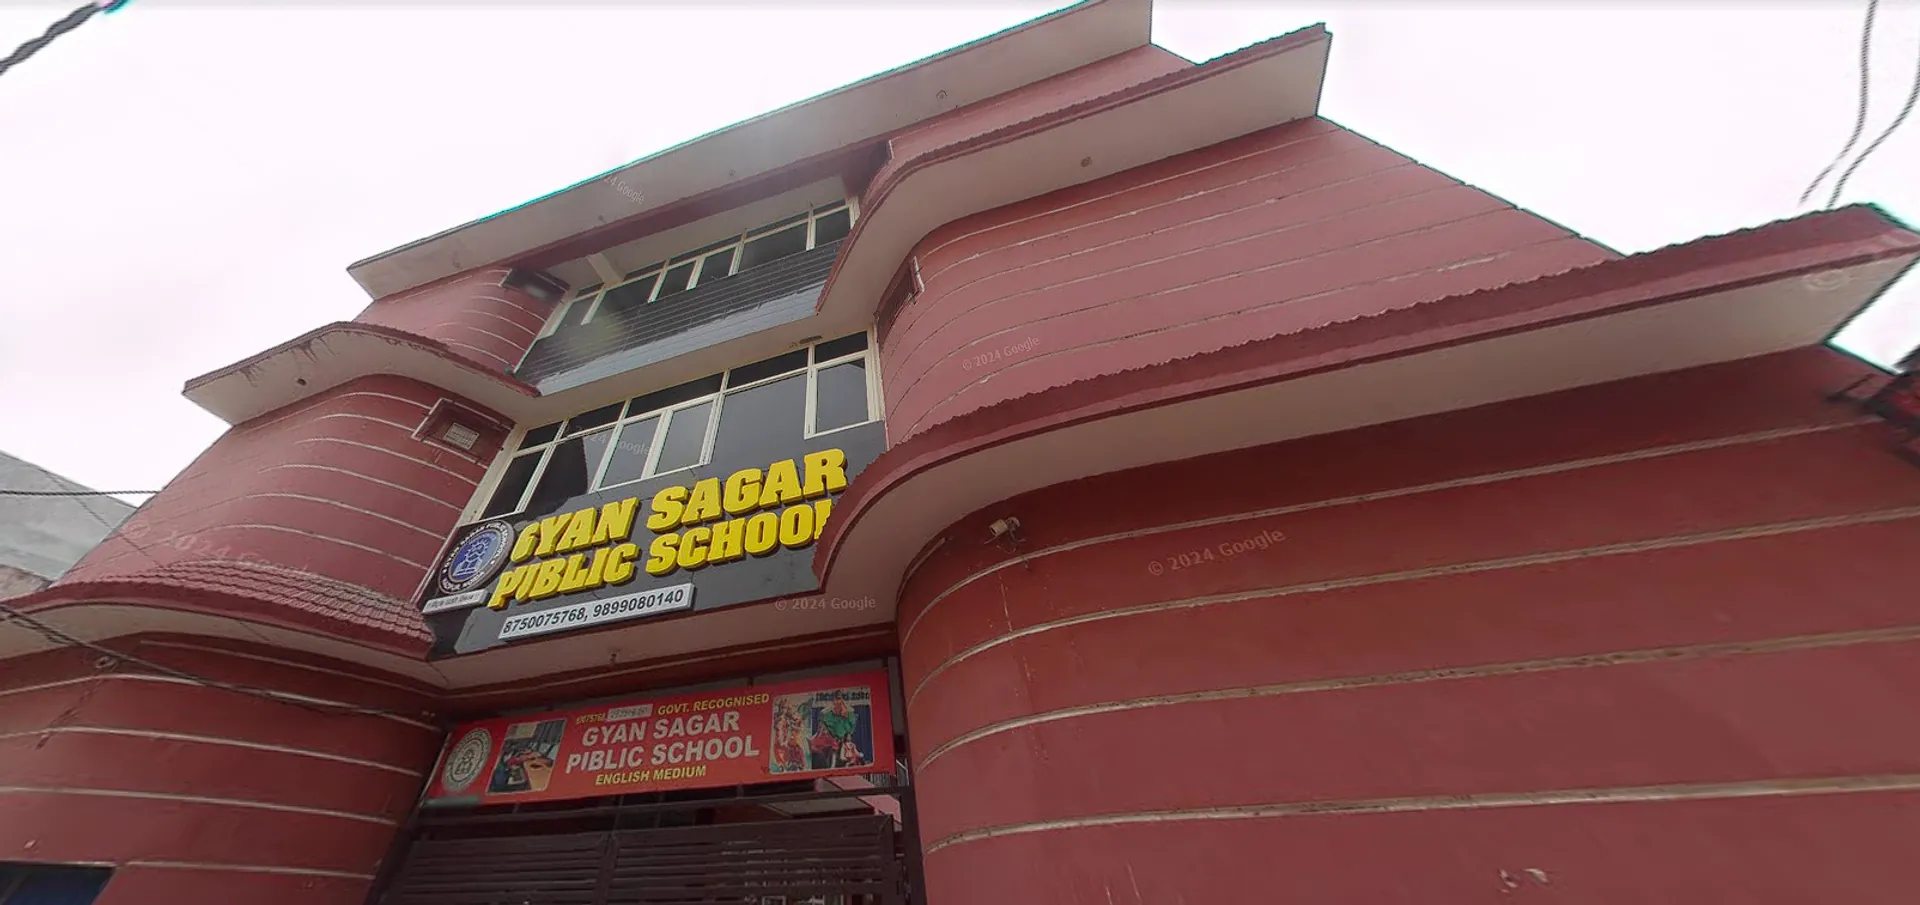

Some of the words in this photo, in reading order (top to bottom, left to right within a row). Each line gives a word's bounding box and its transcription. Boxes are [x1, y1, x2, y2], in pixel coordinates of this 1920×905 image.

[510, 497, 640, 563] GYAN
[647, 448, 849, 532] SAGAR
[502, 607, 588, 634] 8750075768,
[592, 589, 684, 618] 9899080140
[657, 702, 690, 716] GOVT.
[693, 693, 770, 712] RECOGNISED
[582, 721, 648, 747] GYAN
[652, 711, 740, 740] SAGAR
[651, 735, 760, 766] SCHOOL
[595, 769, 649, 786] ENGLISH
[652, 765, 707, 781] MEDIUM
